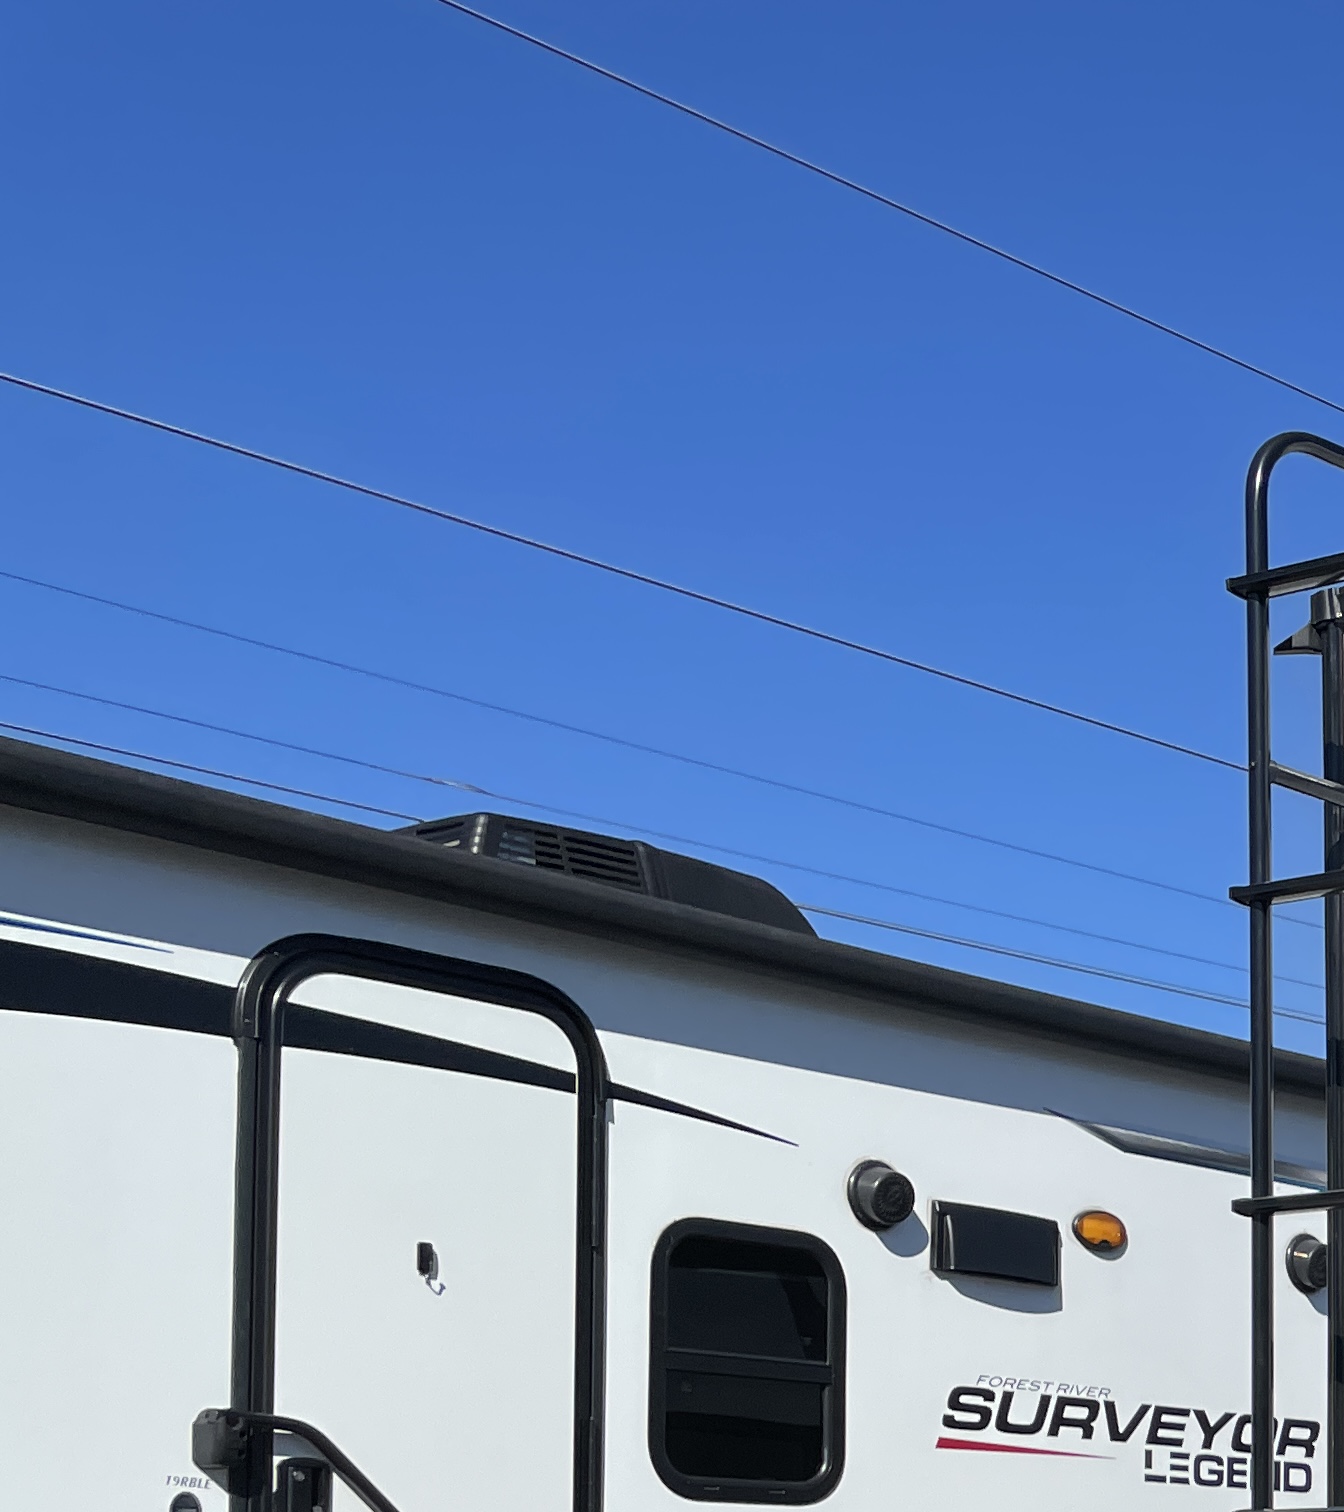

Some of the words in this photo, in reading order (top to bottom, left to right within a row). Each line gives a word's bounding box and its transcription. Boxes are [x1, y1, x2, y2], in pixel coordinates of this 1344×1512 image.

[976, 1374, 1054, 1393] FOREST
[1056, 1383, 1111, 1399] RIVER
[942, 1386, 1321, 1458] SURVEYOR
[1144, 1449, 1313, 1493] LEGED
